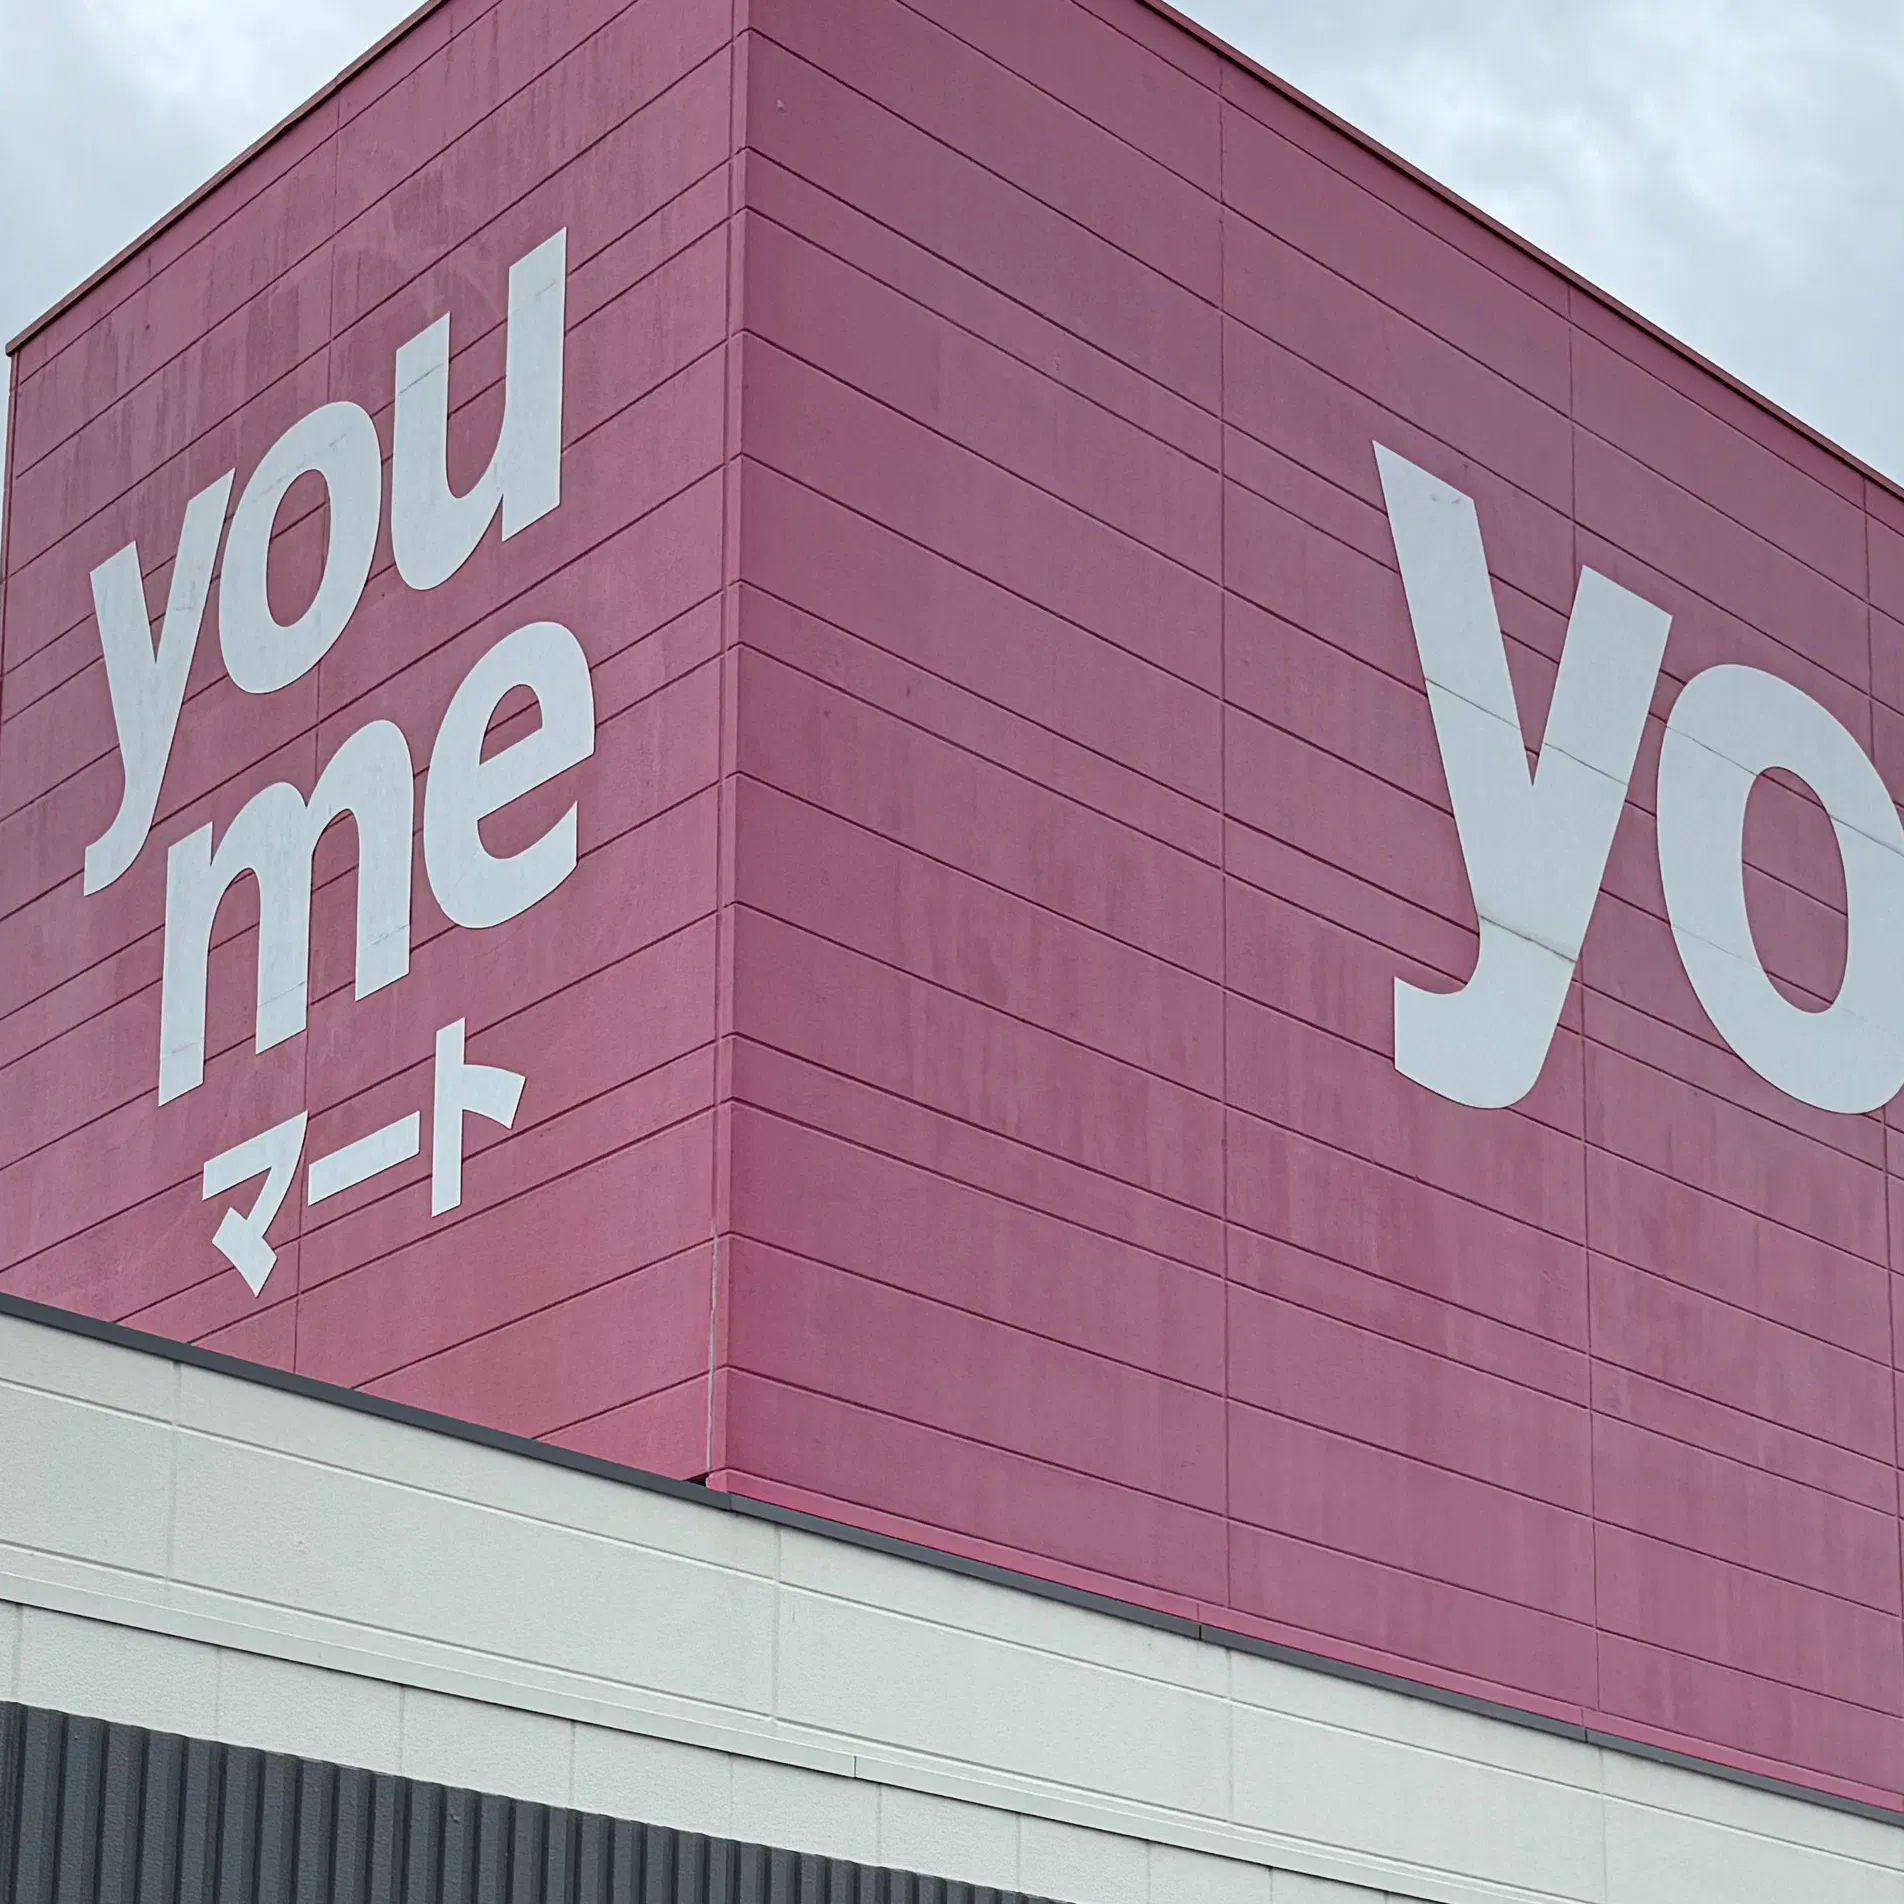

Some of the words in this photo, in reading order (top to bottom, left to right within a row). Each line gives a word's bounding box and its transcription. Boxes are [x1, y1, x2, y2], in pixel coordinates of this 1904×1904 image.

[84, 227, 566, 896] you
[159, 621, 595, 1107] me
[203, 1017, 526, 1296] マート
